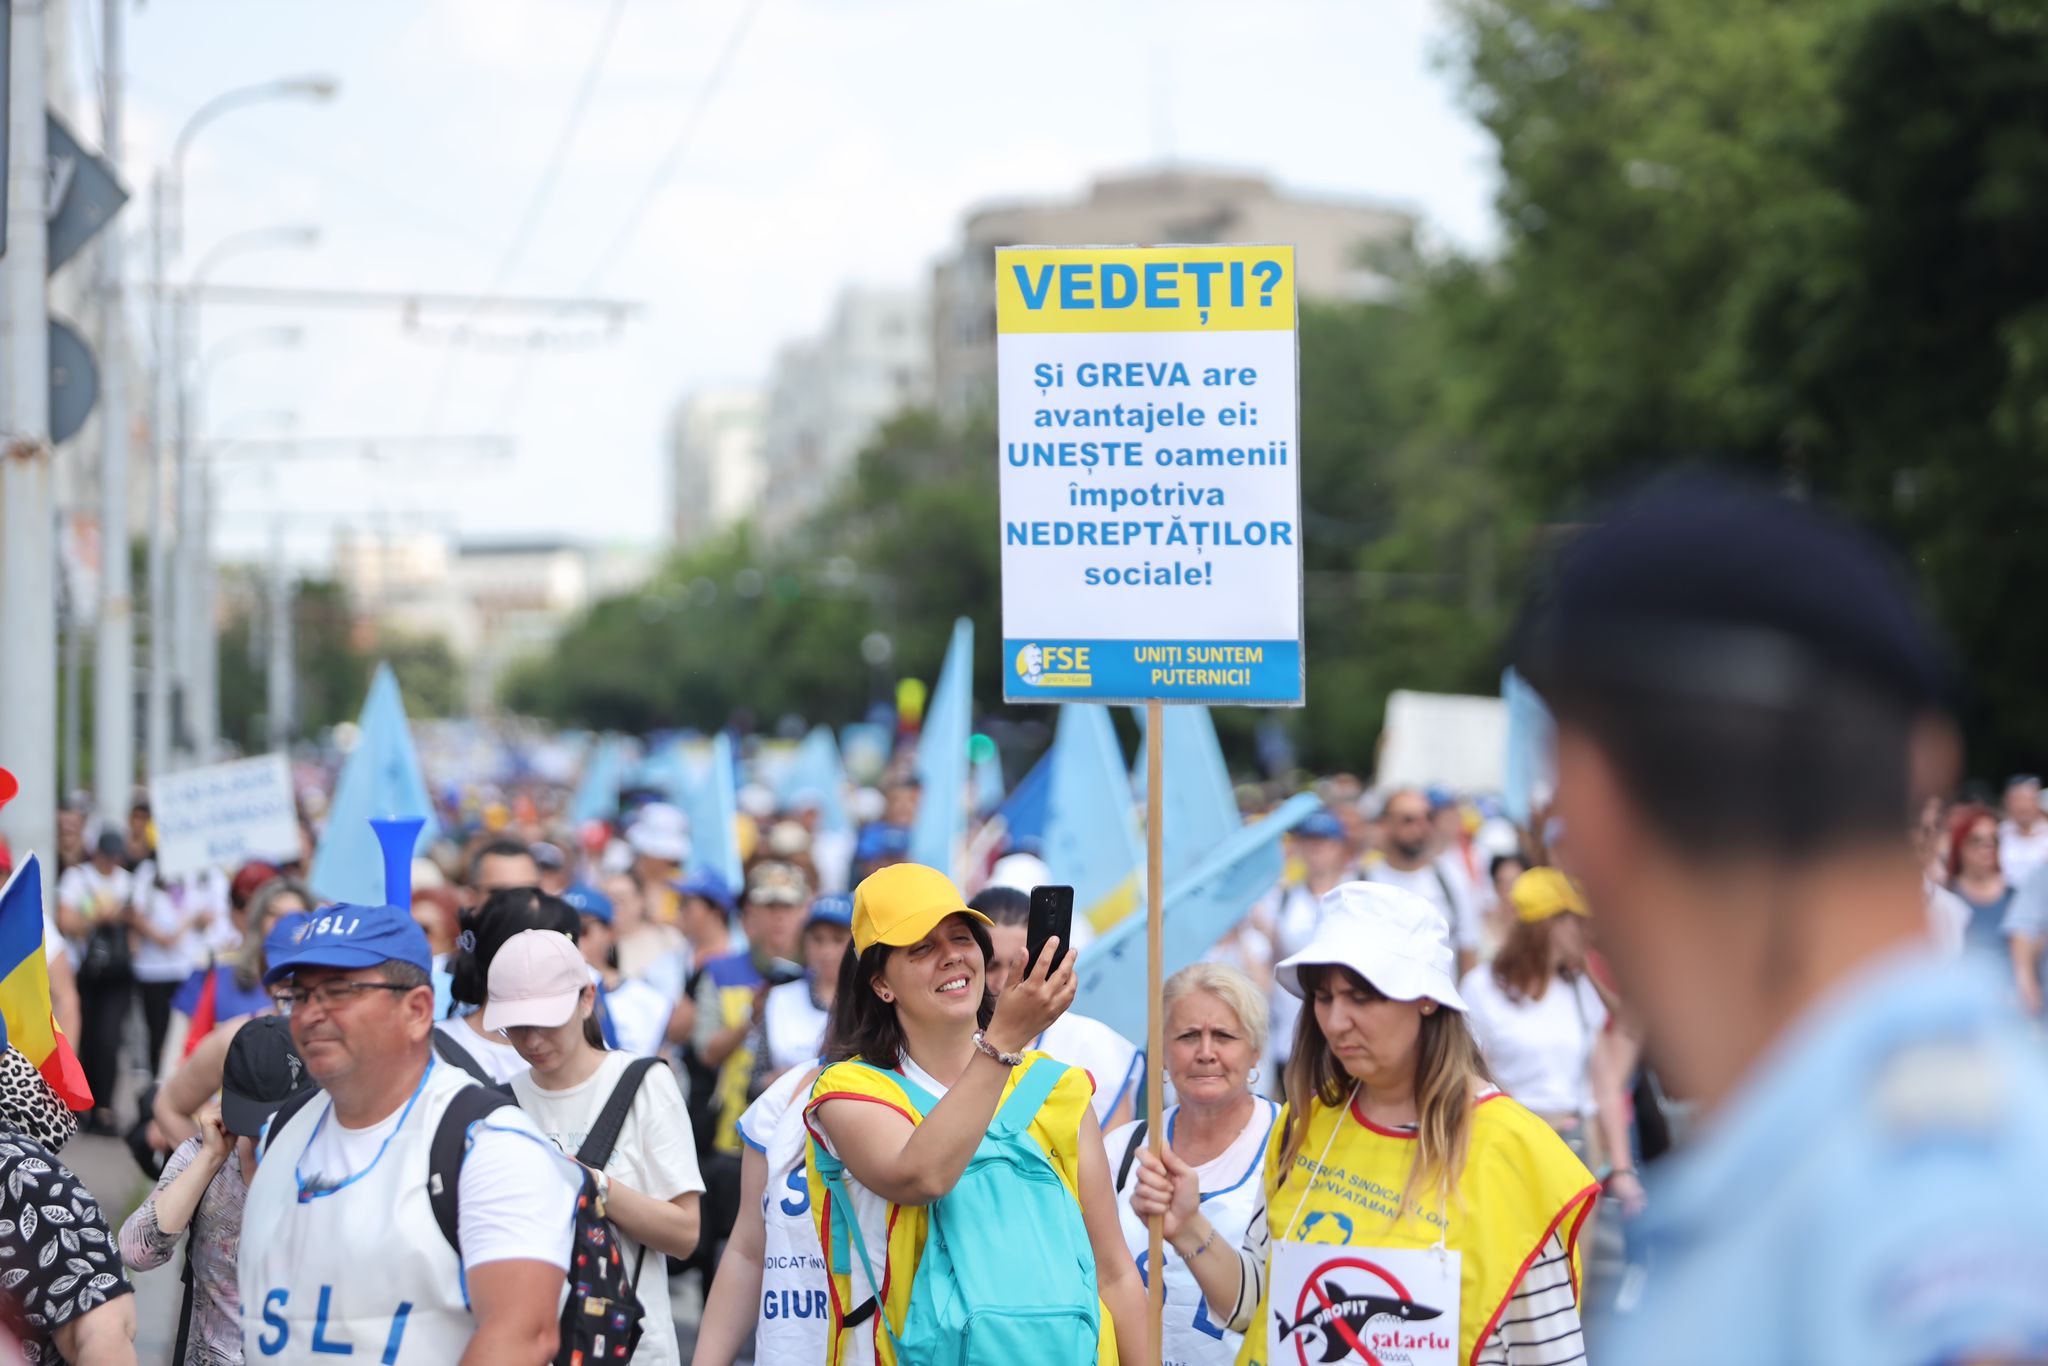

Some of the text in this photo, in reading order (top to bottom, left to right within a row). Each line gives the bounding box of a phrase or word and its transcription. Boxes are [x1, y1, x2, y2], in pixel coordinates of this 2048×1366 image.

[1012, 260, 1283, 325] VEDEȚI?
[1034, 362, 1258, 396] Și GREVA are
[1034, 402, 1258, 433] avantajele ei:
[1008, 441, 1288, 475] UNEȘTE oamenii
[1069, 482, 1225, 513] împotriva
[1006, 515, 1293, 554] NEDREPTĂȚILOR
[1084, 561, 1213, 586] sociale!
[1043, 647, 1090, 670] FSE
[1134, 647, 1263, 667] UNIȚI SUNTEM
[1152, 668, 1250, 686] PUTERNICI!
[764, 1289, 828, 1320] GIUR
[1313, 1300, 1369, 1327] PROFIT
[241, 1284, 414, 1366] SLI
